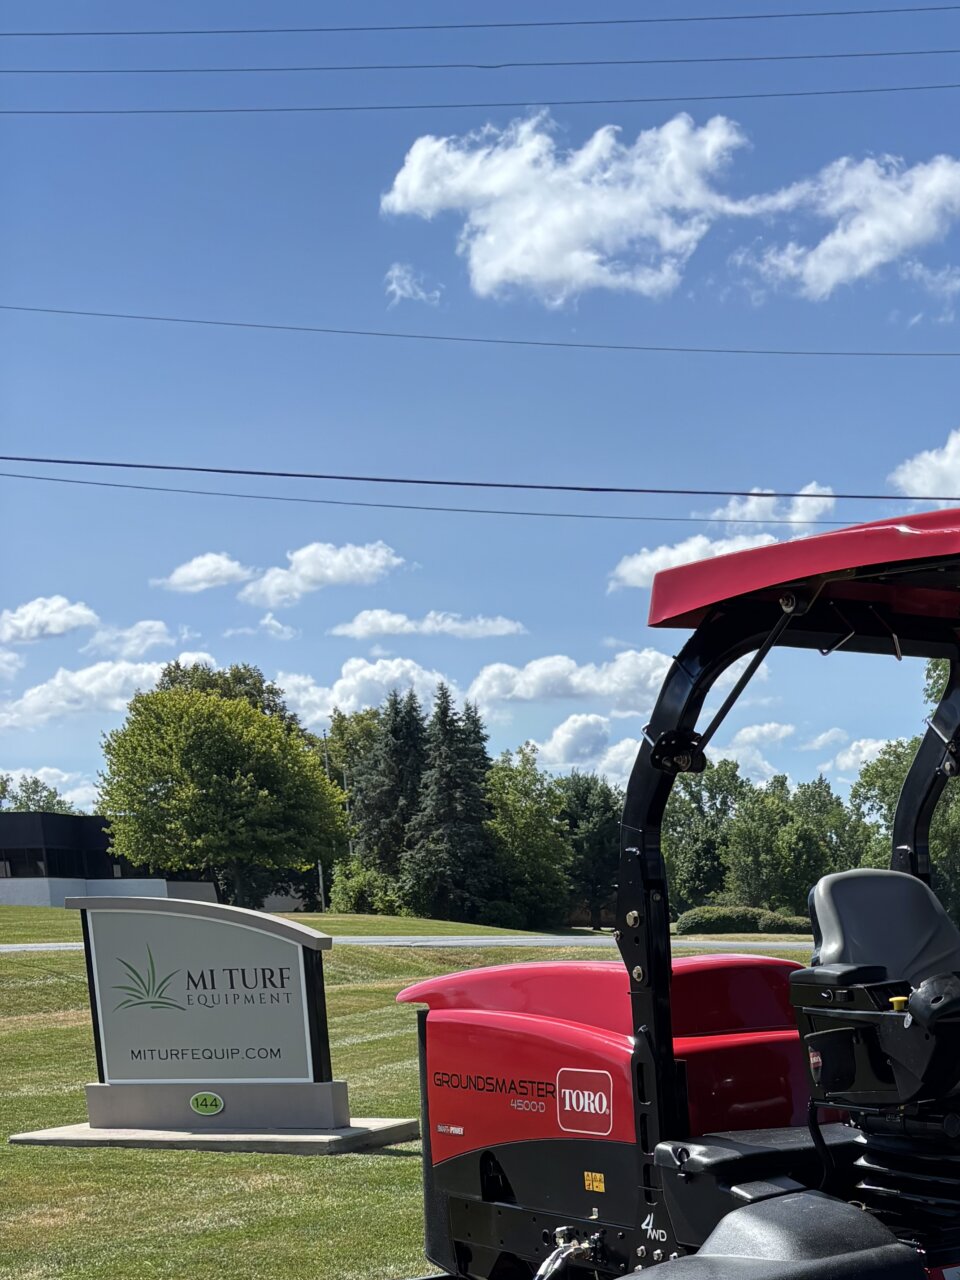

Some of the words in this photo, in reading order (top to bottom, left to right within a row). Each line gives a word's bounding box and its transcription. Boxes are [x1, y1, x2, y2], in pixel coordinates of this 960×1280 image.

[186, 969, 216, 990] MI
[222, 967, 291, 989] TURF
[187, 992, 292, 1008] EQUIPMENT
[130, 1047, 282, 1061] MITURFEQUIP.COM
[433, 1071, 556, 1099] GROUNDSMASTER
[194, 1097, 219, 1108] 144
[561, 1088, 608, 1115] TORO
